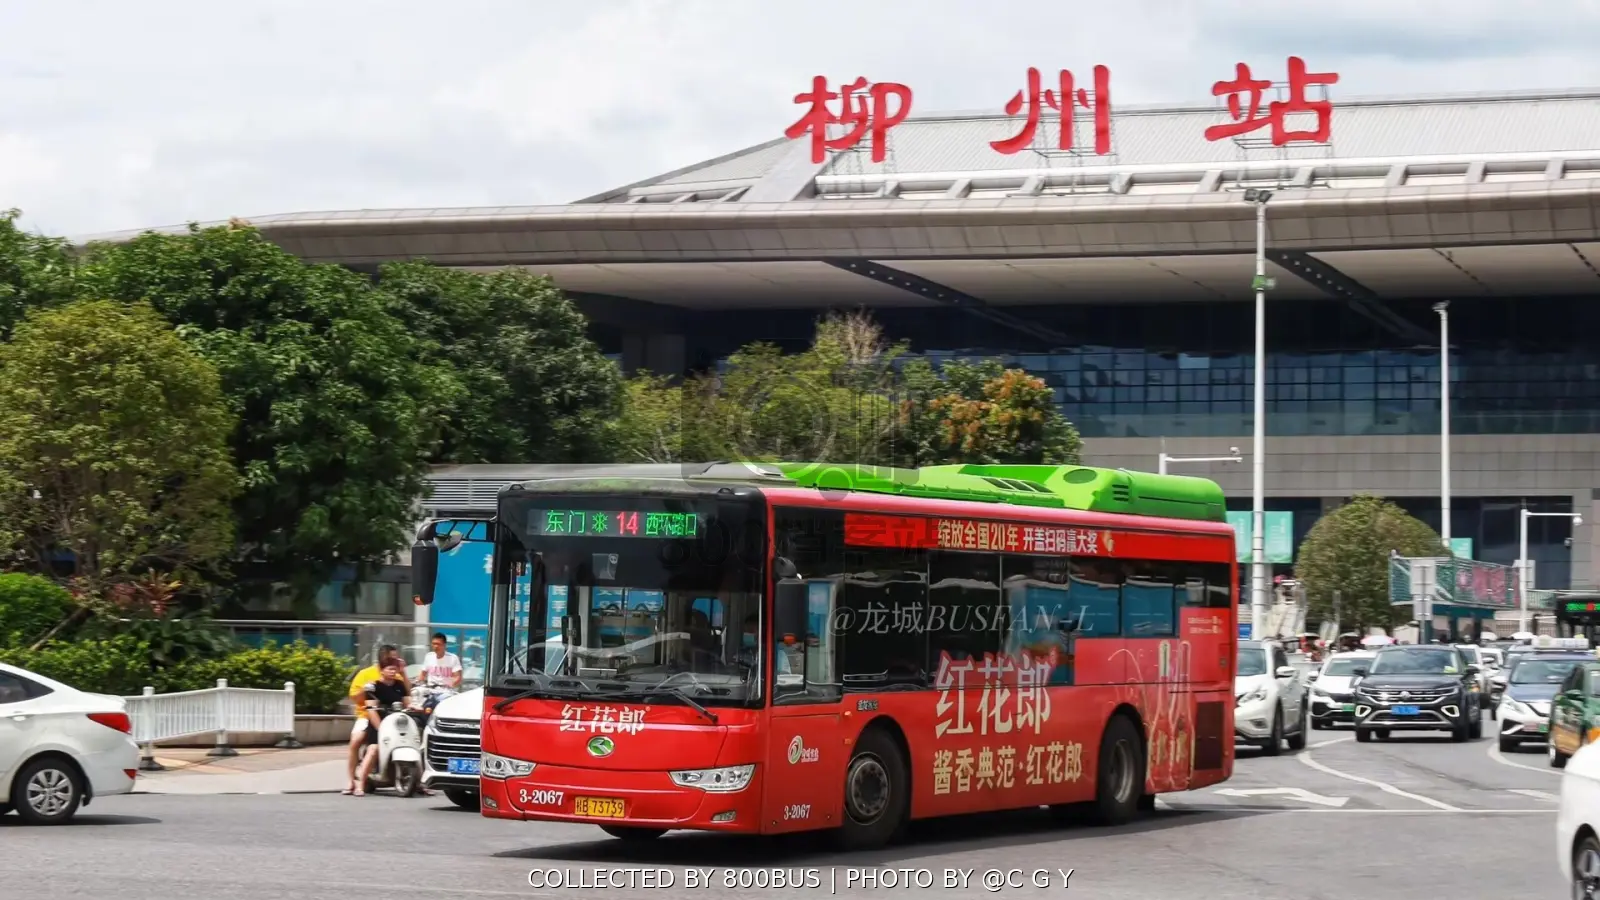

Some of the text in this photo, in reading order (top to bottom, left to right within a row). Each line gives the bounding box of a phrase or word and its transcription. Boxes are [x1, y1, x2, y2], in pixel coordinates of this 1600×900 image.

[785, 56, 1340, 164] 柳州站
[545, 510, 697, 536] 东门 14 西环路口
[937, 519, 1098, 554] 绽放全国20年 开盖扫码赢大奖
[935, 654, 1051, 738] 红花郎
[560, 704, 645, 735] 红花郎
[519, 790, 563, 806] 3-2067
[784, 805, 810, 820] 3-2067
